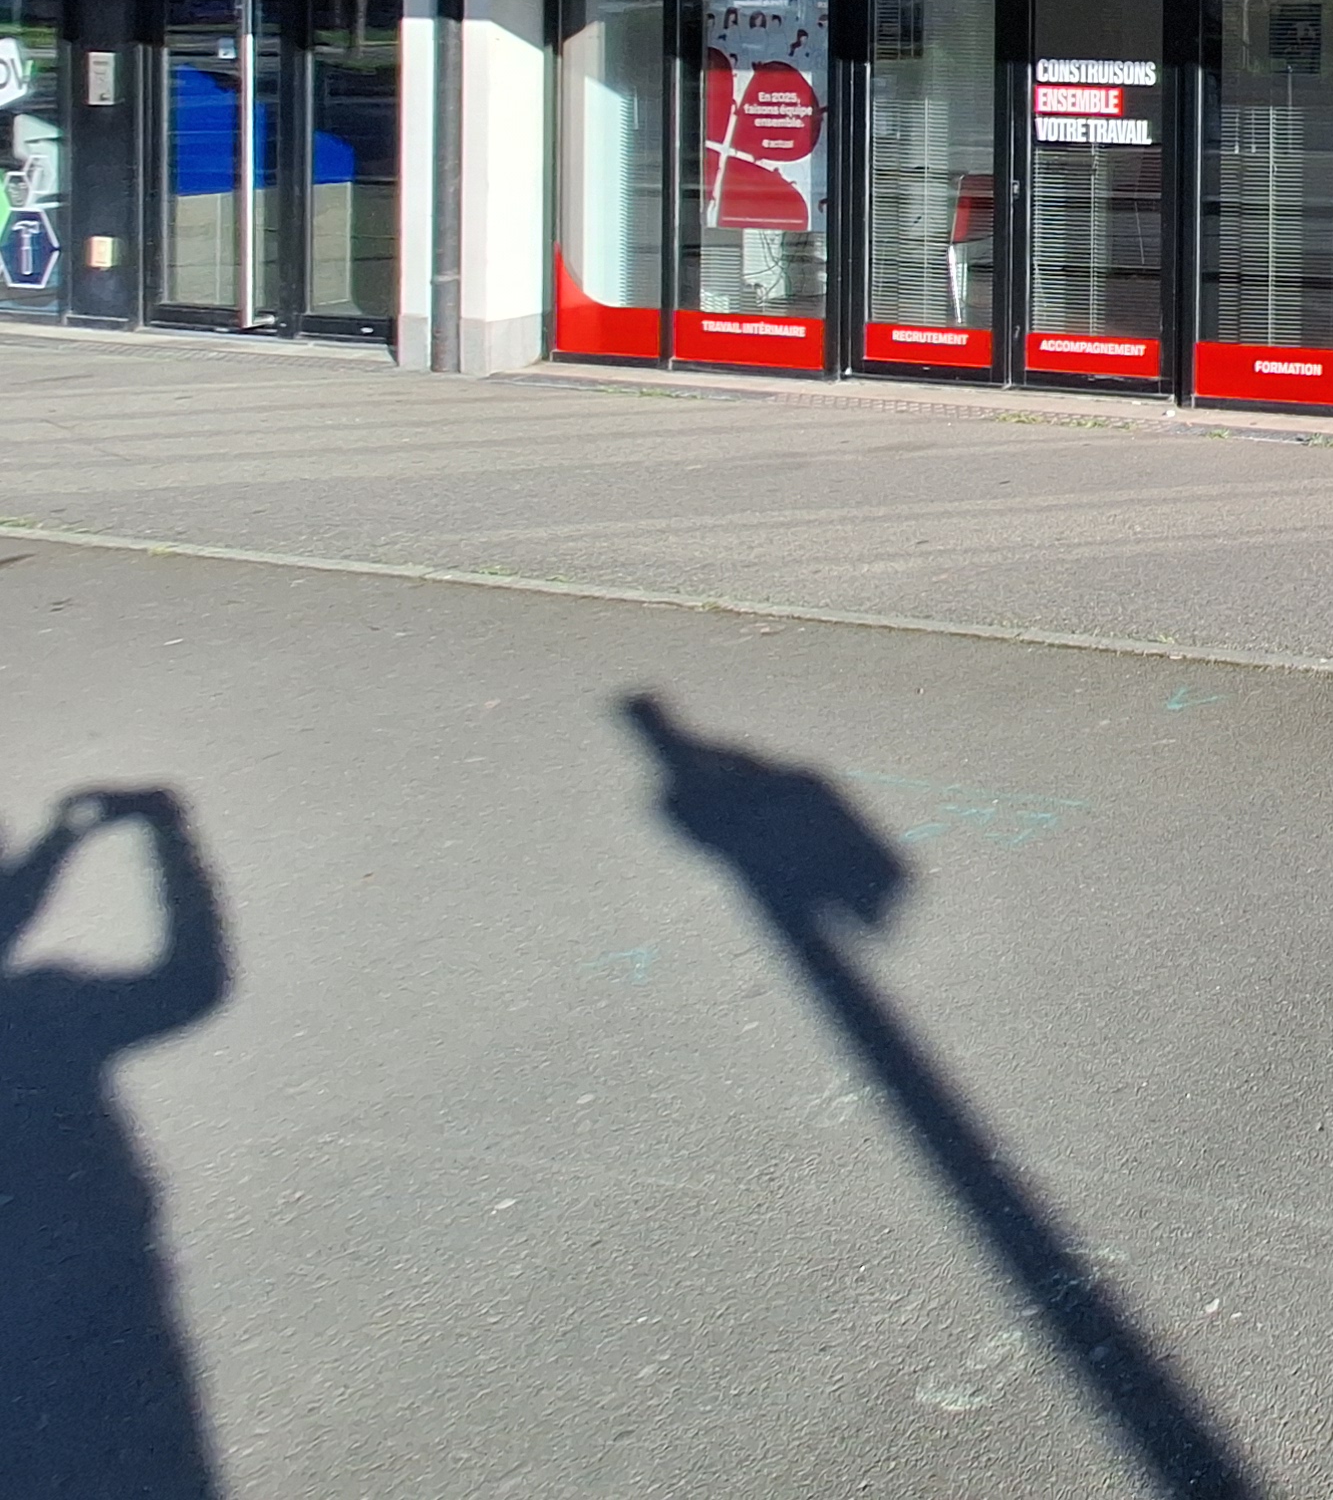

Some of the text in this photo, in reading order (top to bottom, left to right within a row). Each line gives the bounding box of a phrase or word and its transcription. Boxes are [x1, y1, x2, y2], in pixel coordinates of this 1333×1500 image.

[1036, 59, 1157, 86] CONSTRUISONS
[1038, 88, 1119, 114] ENSEMBLE
[1035, 118, 1152, 145] VOTRE TRAVAIL
[701, 320, 806, 338] TRAVAIL INTÉRIMAIRE
[892, 330, 969, 346] RECRUTEMENT
[1039, 340, 1147, 357] ACCOMPAGNEMENT
[1254, 360, 1323, 376] FORMATION
